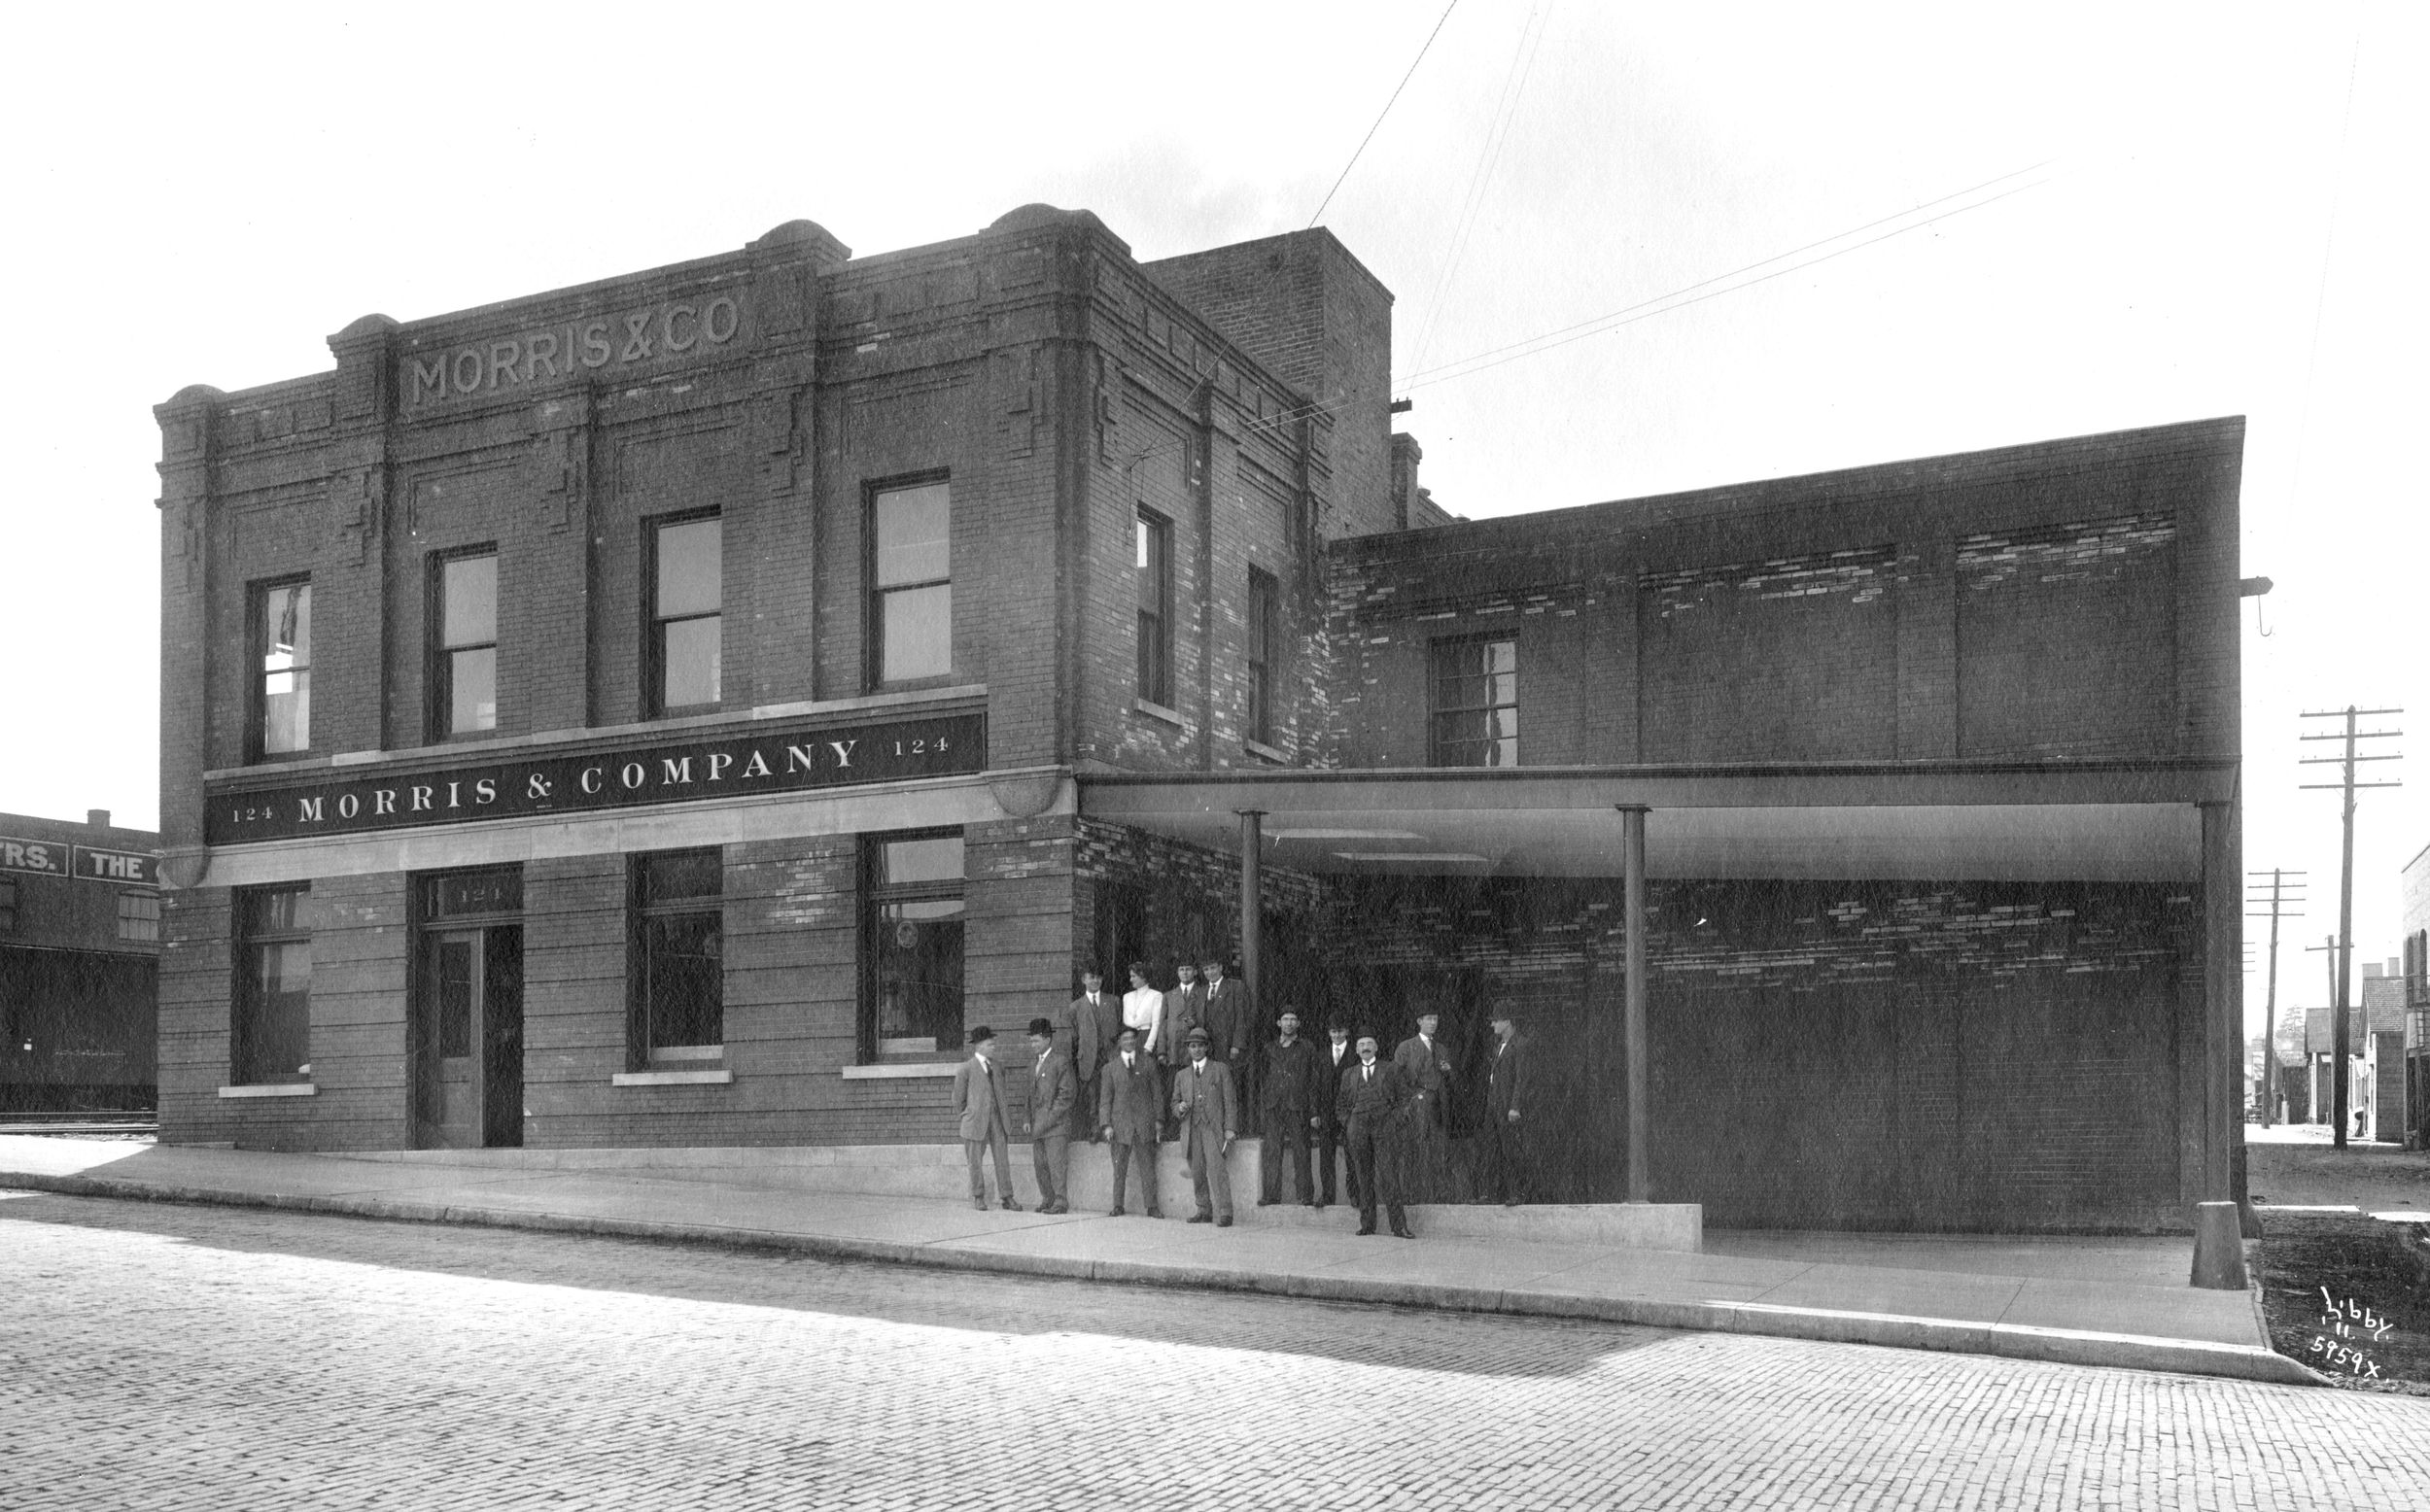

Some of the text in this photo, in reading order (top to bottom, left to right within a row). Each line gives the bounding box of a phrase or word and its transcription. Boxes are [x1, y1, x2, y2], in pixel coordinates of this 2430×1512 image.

[232, 736, 950, 823] 124 MORRIS & COMPANY 124
[0, 842, 56, 871] RS.
[89, 851, 144, 879] THE
